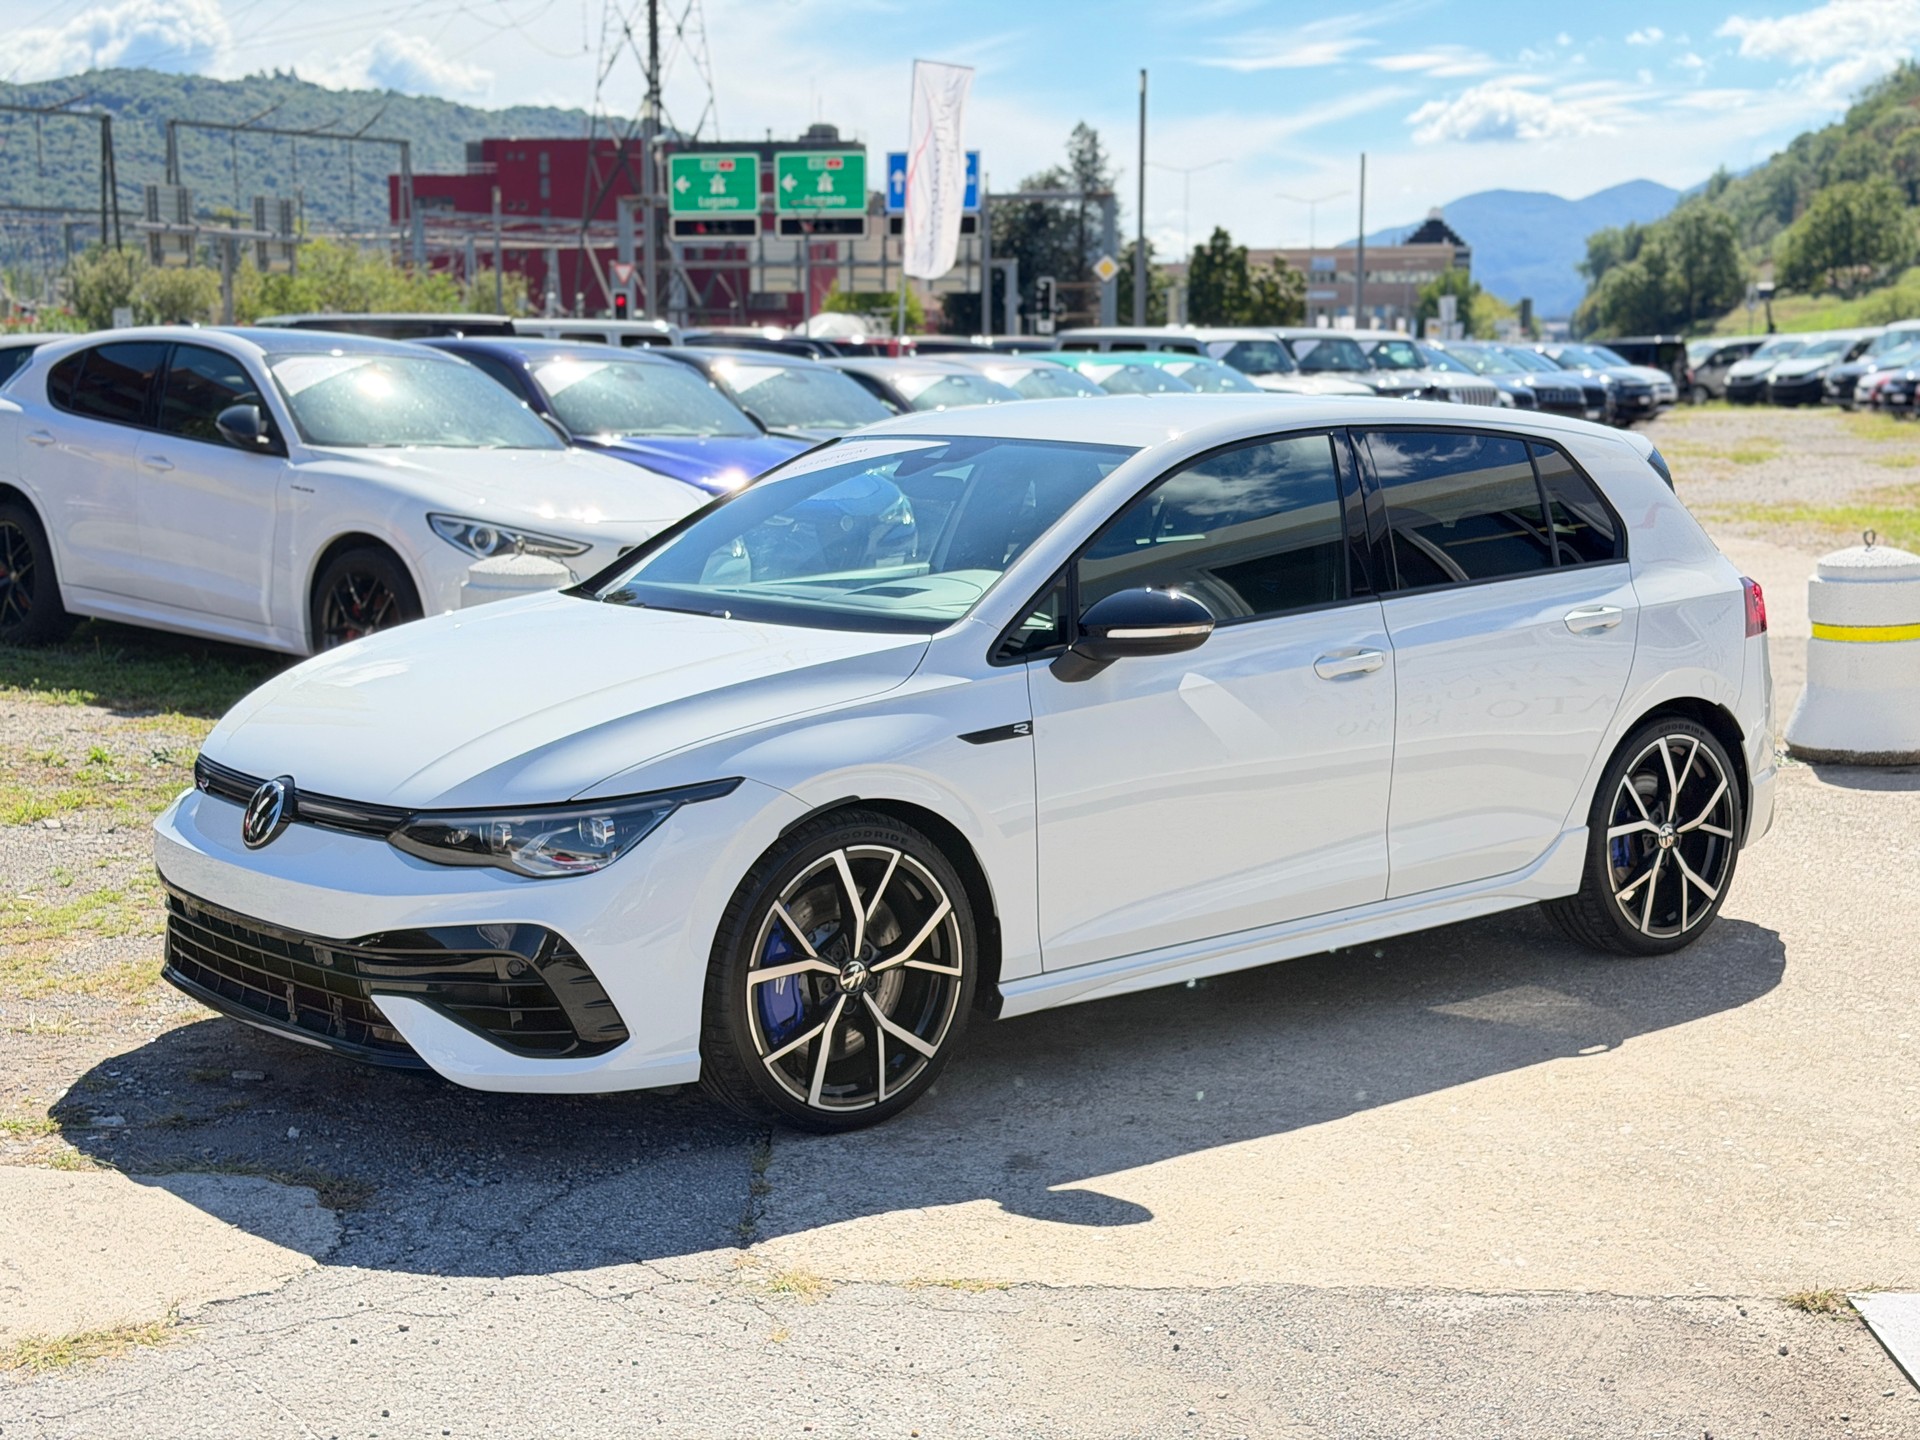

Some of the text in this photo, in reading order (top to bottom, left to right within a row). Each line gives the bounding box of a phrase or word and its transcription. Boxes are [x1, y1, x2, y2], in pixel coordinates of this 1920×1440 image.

[698, 195, 739, 209] Lugano
[1013, 722, 1030, 735] R
[829, 830, 908, 846] GOODRIDE
